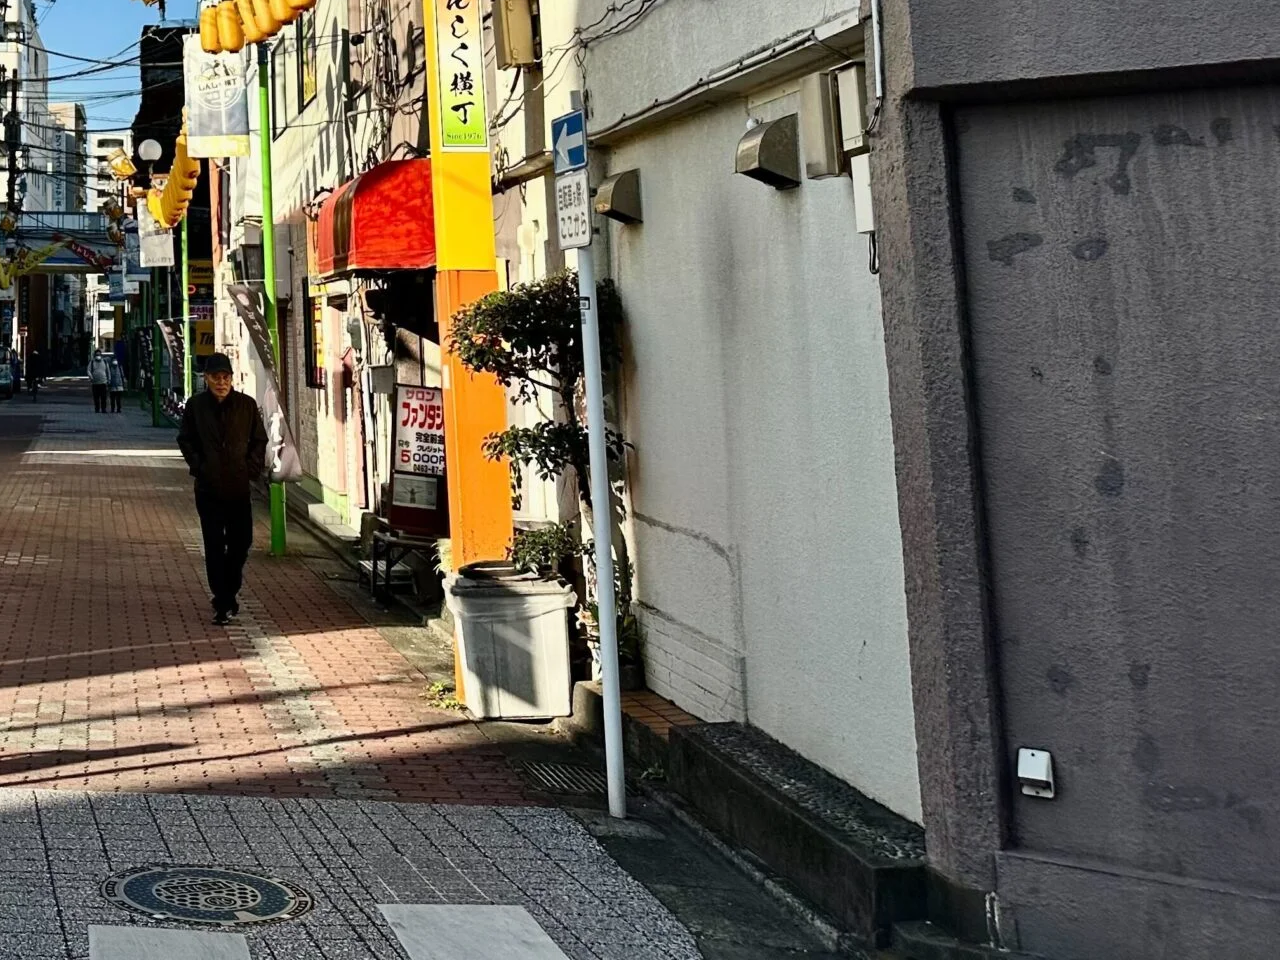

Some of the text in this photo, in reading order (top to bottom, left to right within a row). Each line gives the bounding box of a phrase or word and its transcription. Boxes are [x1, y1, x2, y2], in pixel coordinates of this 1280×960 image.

[559, 212, 587, 239] ここから
[406, 389, 435, 401] サロン
[417, 445, 444, 453] クレジット
